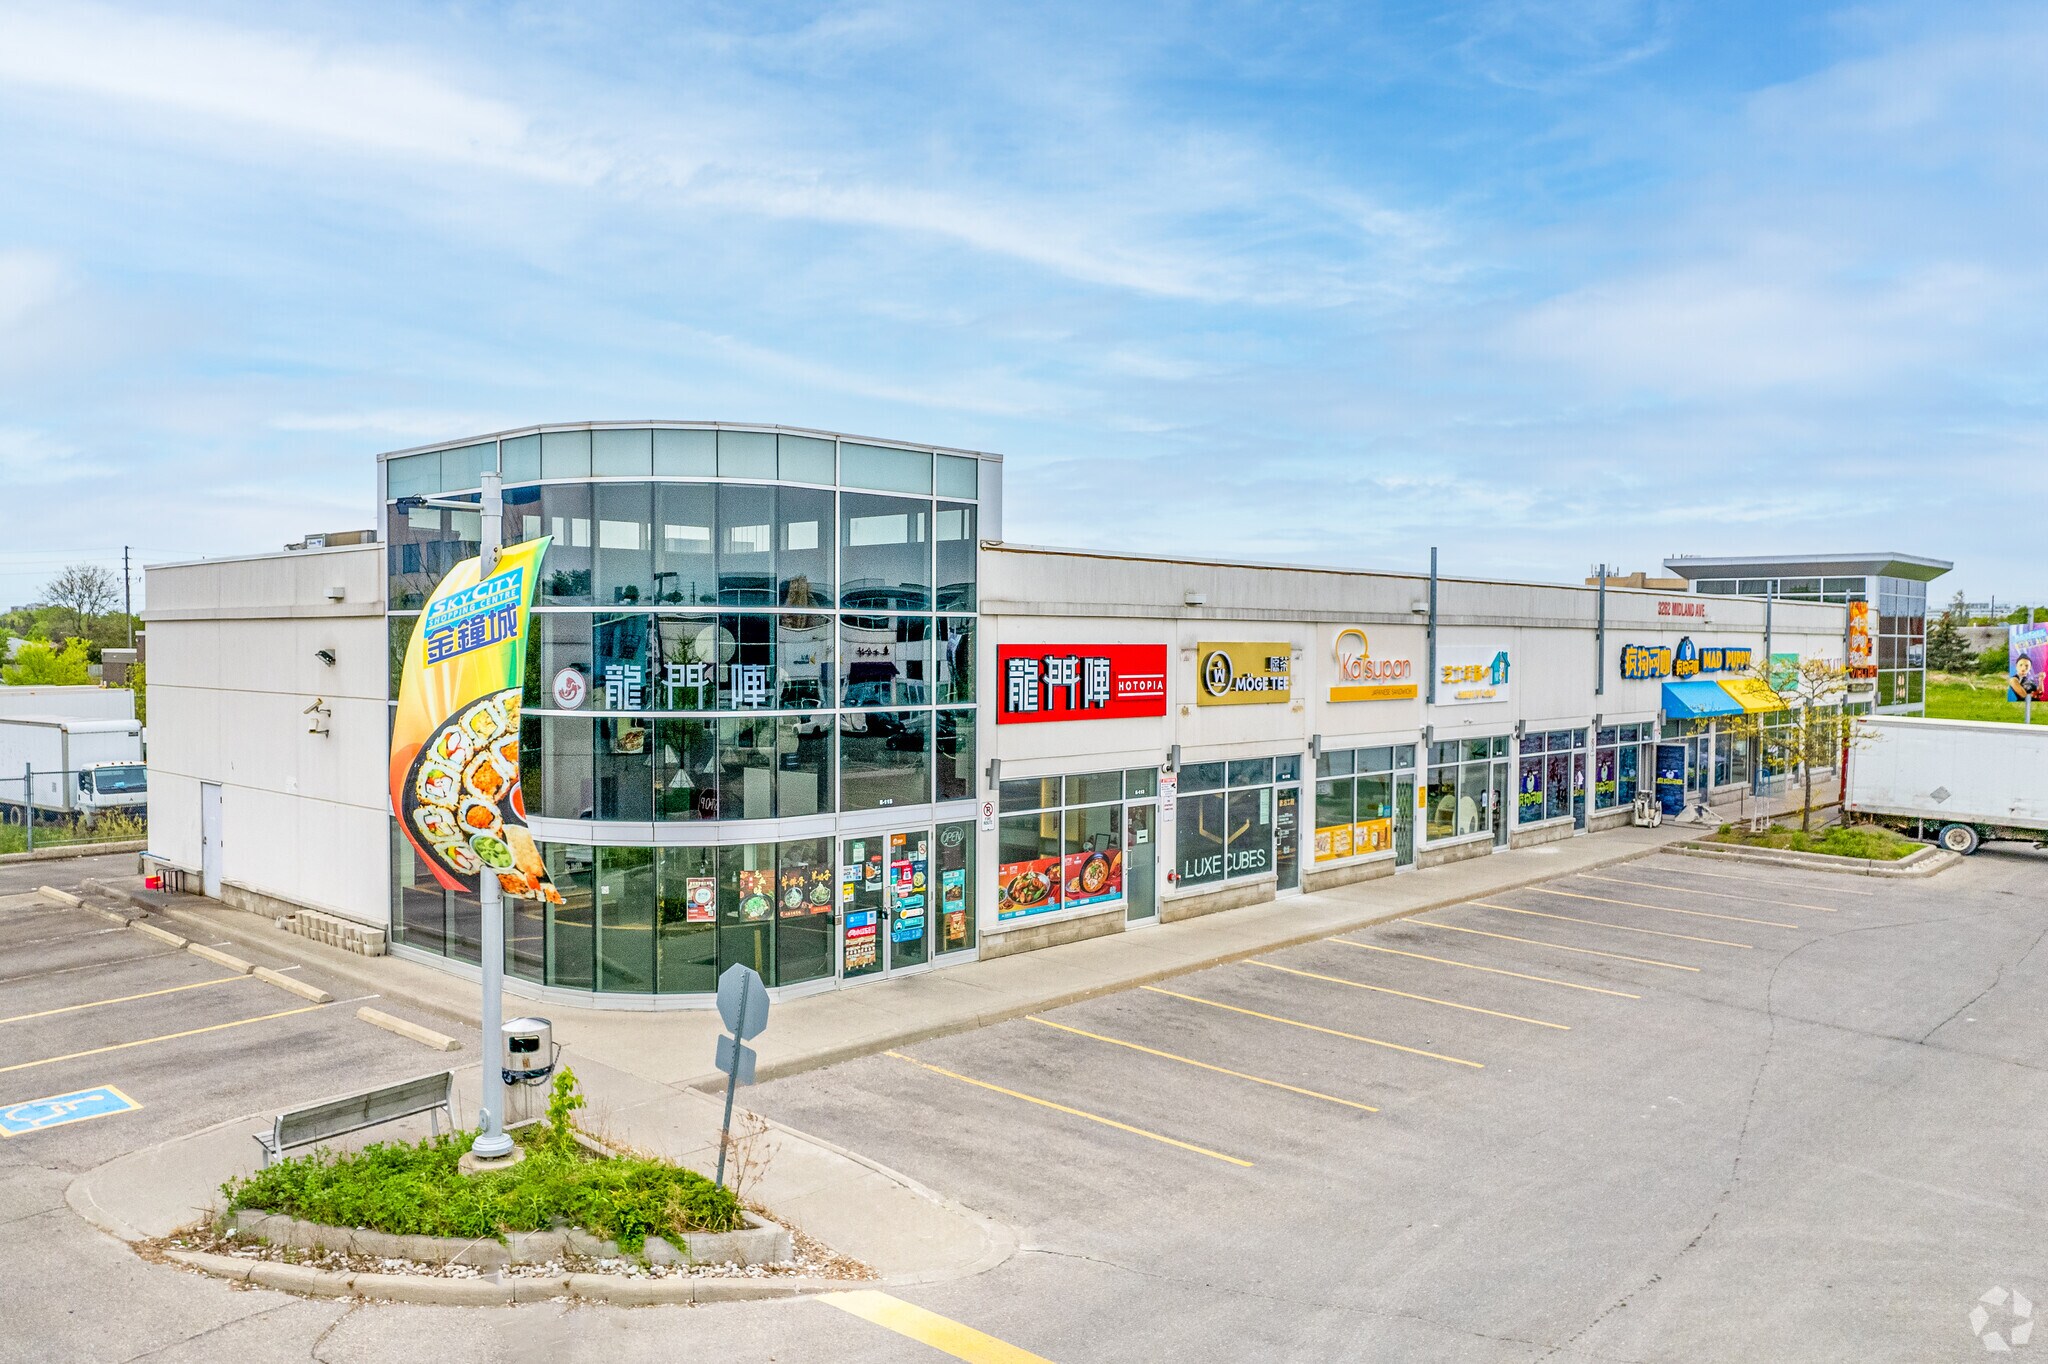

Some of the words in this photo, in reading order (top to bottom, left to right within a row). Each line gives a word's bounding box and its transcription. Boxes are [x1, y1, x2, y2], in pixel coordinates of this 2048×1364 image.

[428, 603, 476, 627] SHOPPING
[479, 589, 516, 608] CENTRE
[1671, 602, 1694, 617] MIDLAND
[427, 602, 518, 665] 金鐘城
[1342, 652, 1411, 683] Katsupan
[1702, 650, 1723, 669] MAD
[1725, 650, 1752, 670] PUPPY
[1006, 655, 1111, 712] 龍門陣
[1117, 680, 1164, 691] HOTOPIA
[1235, 673, 1269, 692] MÖGE
[1270, 676, 1290, 691] TEE
[1185, 855, 1222, 878] LUXE
[1227, 848, 1266, 872] CUBES
